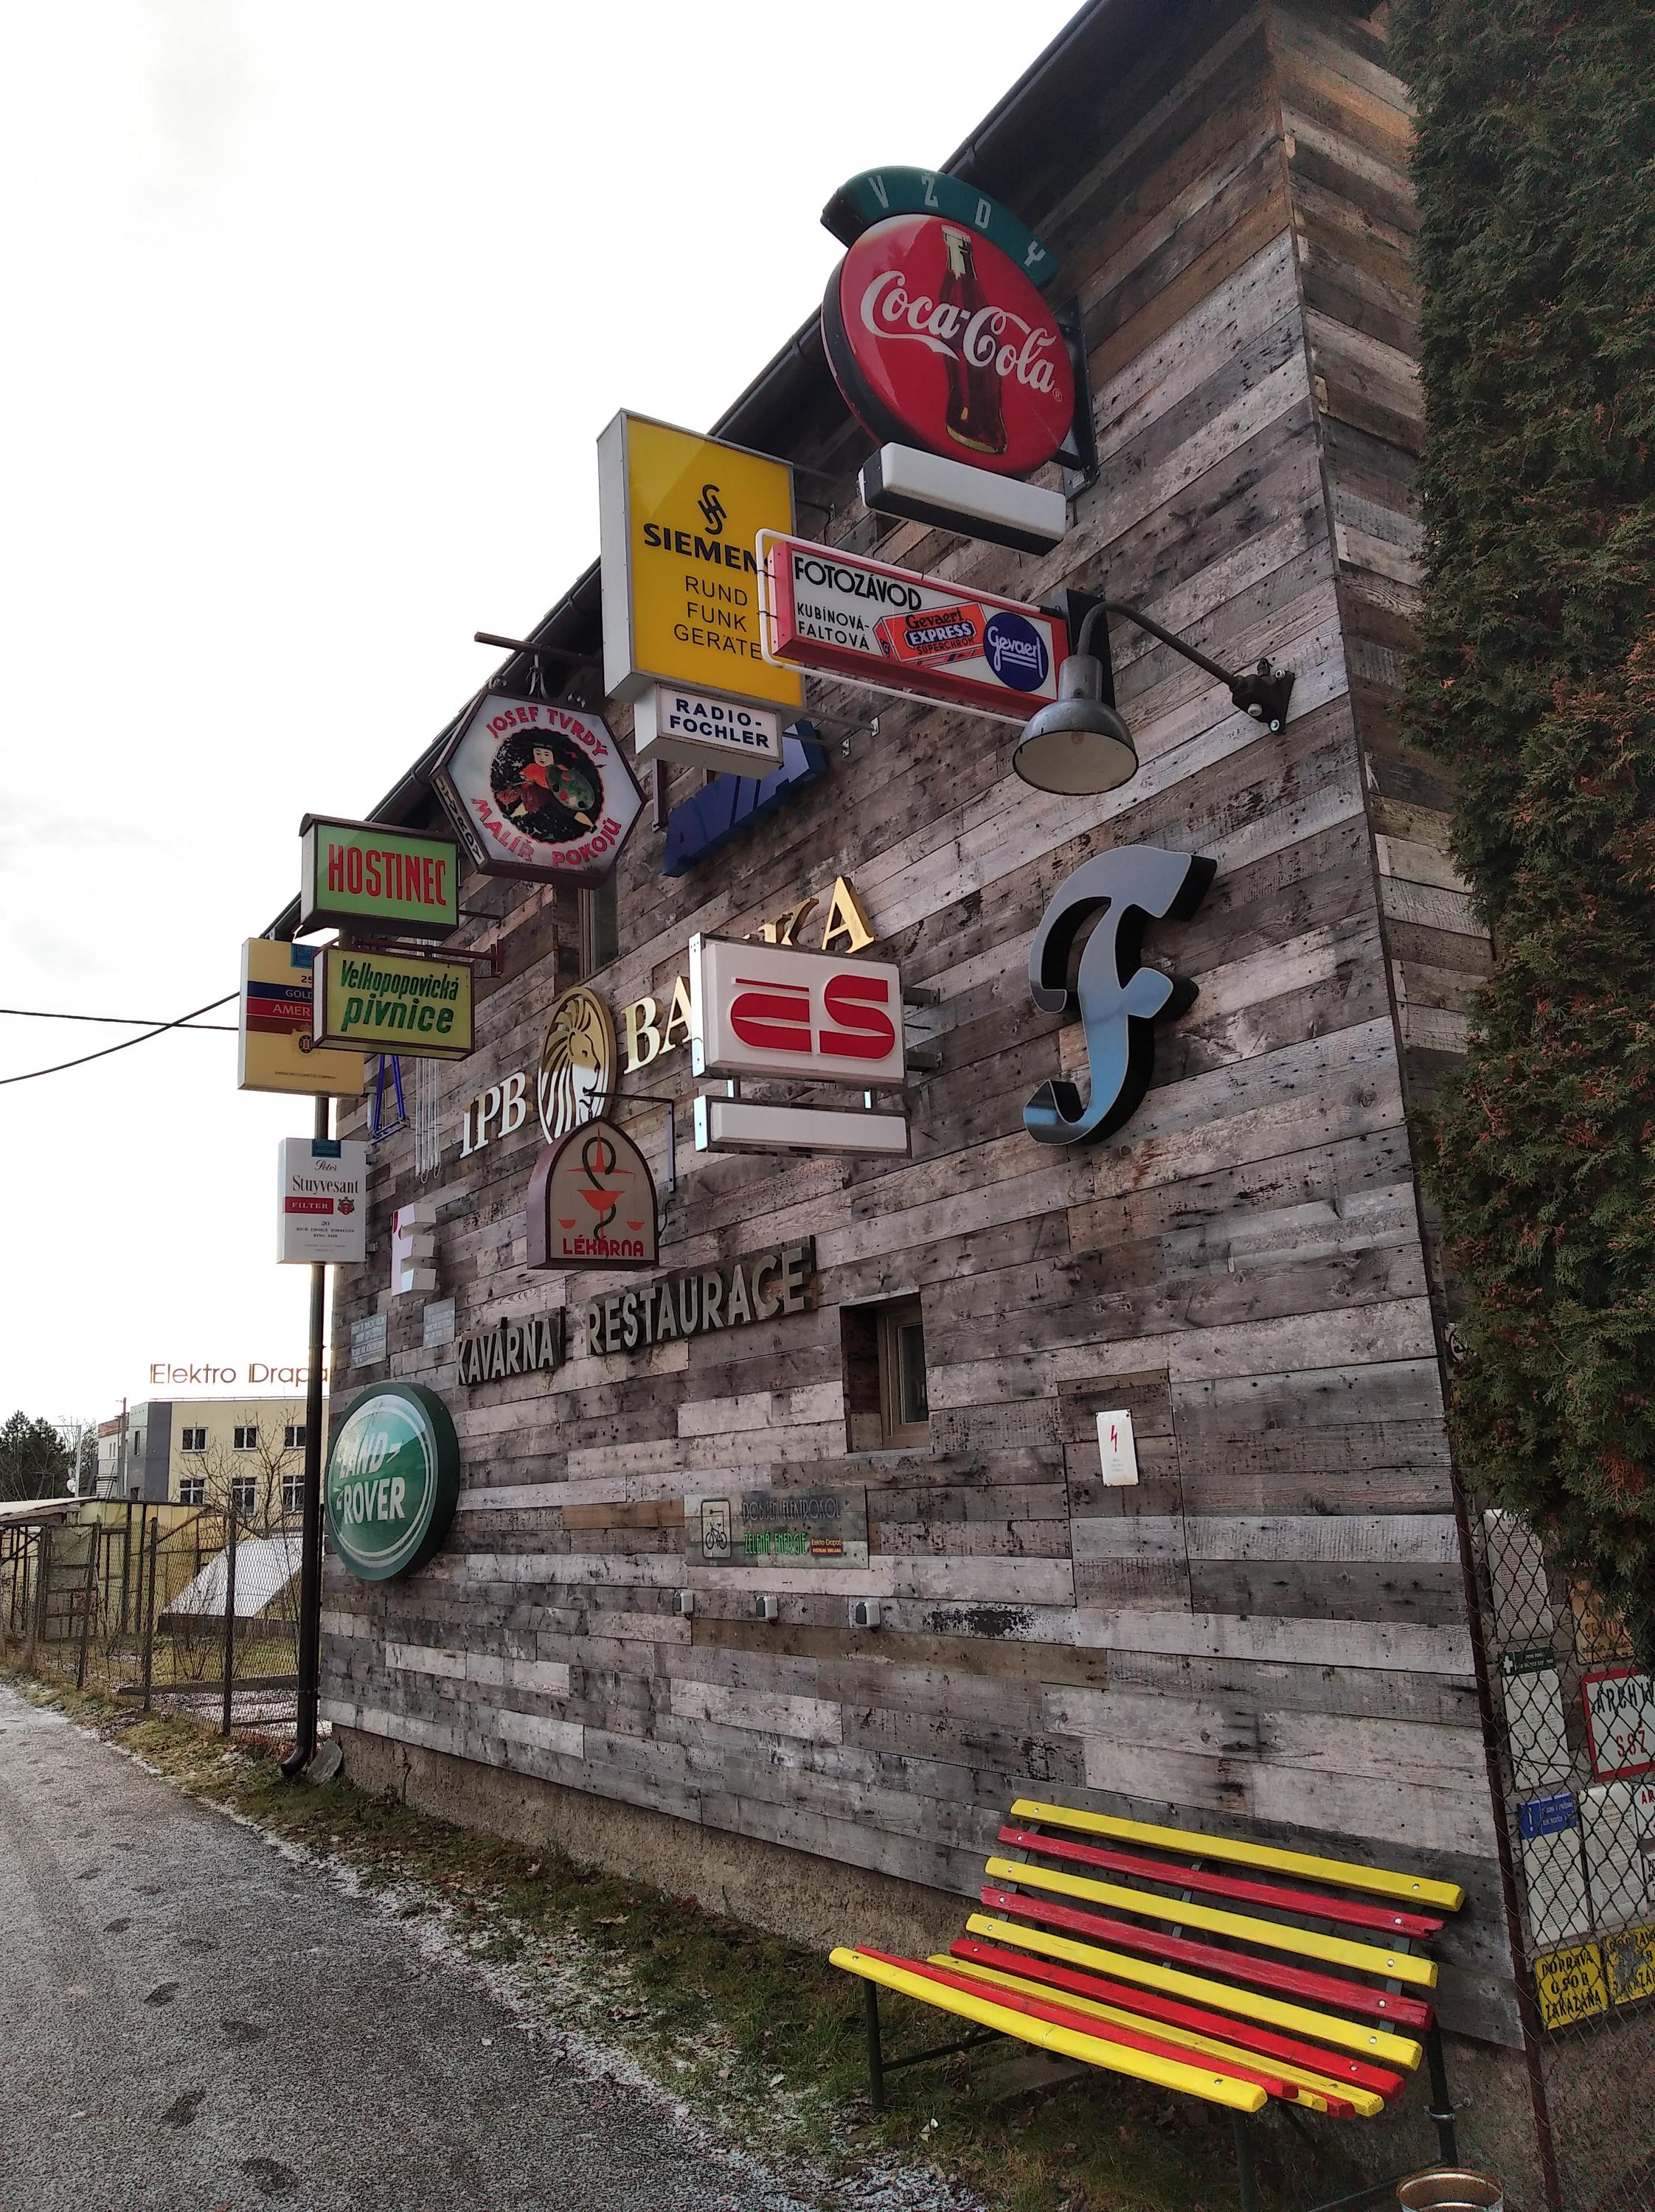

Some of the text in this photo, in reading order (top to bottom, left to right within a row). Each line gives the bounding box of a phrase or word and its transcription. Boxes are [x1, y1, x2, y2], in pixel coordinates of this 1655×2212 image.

[867, 172, 1046, 267] VŽDY
[861, 271, 1058, 393] Coca-Cola
[643, 523, 768, 574] SIEMEN
[685, 575, 748, 606] RUND
[794, 556, 922, 611] FOTOZÁVOD
[687, 602, 747, 633] FUNK
[797, 602, 870, 631] KUBÍNOVÁ-
[905, 608, 965, 629] Gevaert
[673, 624, 763, 661] GERÄTE
[798, 621, 870, 651] FALTOVÁ
[909, 622, 972, 645] EXPRESS
[916, 636, 974, 655] SUPERCHROM
[485, 706, 539, 740] JOSEF
[676, 698, 762, 727] RADIO-
[670, 714, 770, 748] FOCHLER
[471, 798, 535, 861] MALÍŘ
[328, 844, 446, 906] HOSTINEC
[340, 959, 460, 1001] Velkopopovická
[340, 992, 455, 1034] pivnice
[459, 1071, 531, 1159] IPB
[314, 1160, 337, 1172] Peter
[292, 1175, 358, 1194] Stuyvesant
[563, 1236, 644, 1257] LÉKÁRNA
[457, 1317, 555, 1385] KAVÁRNA
[586, 1245, 806, 1355] RESTAURACE
[150, 1363, 237, 1384] Elektro
[344, 1476, 406, 1525] ROVER
[783, 1498, 841, 1520] ELEKTROKOL
[744, 1530, 807, 1555] ZELENÁ ENERGIE
[1541, 1950, 1594, 1978] DOPRAVA
[1550, 1972, 1589, 1995] OSOB
